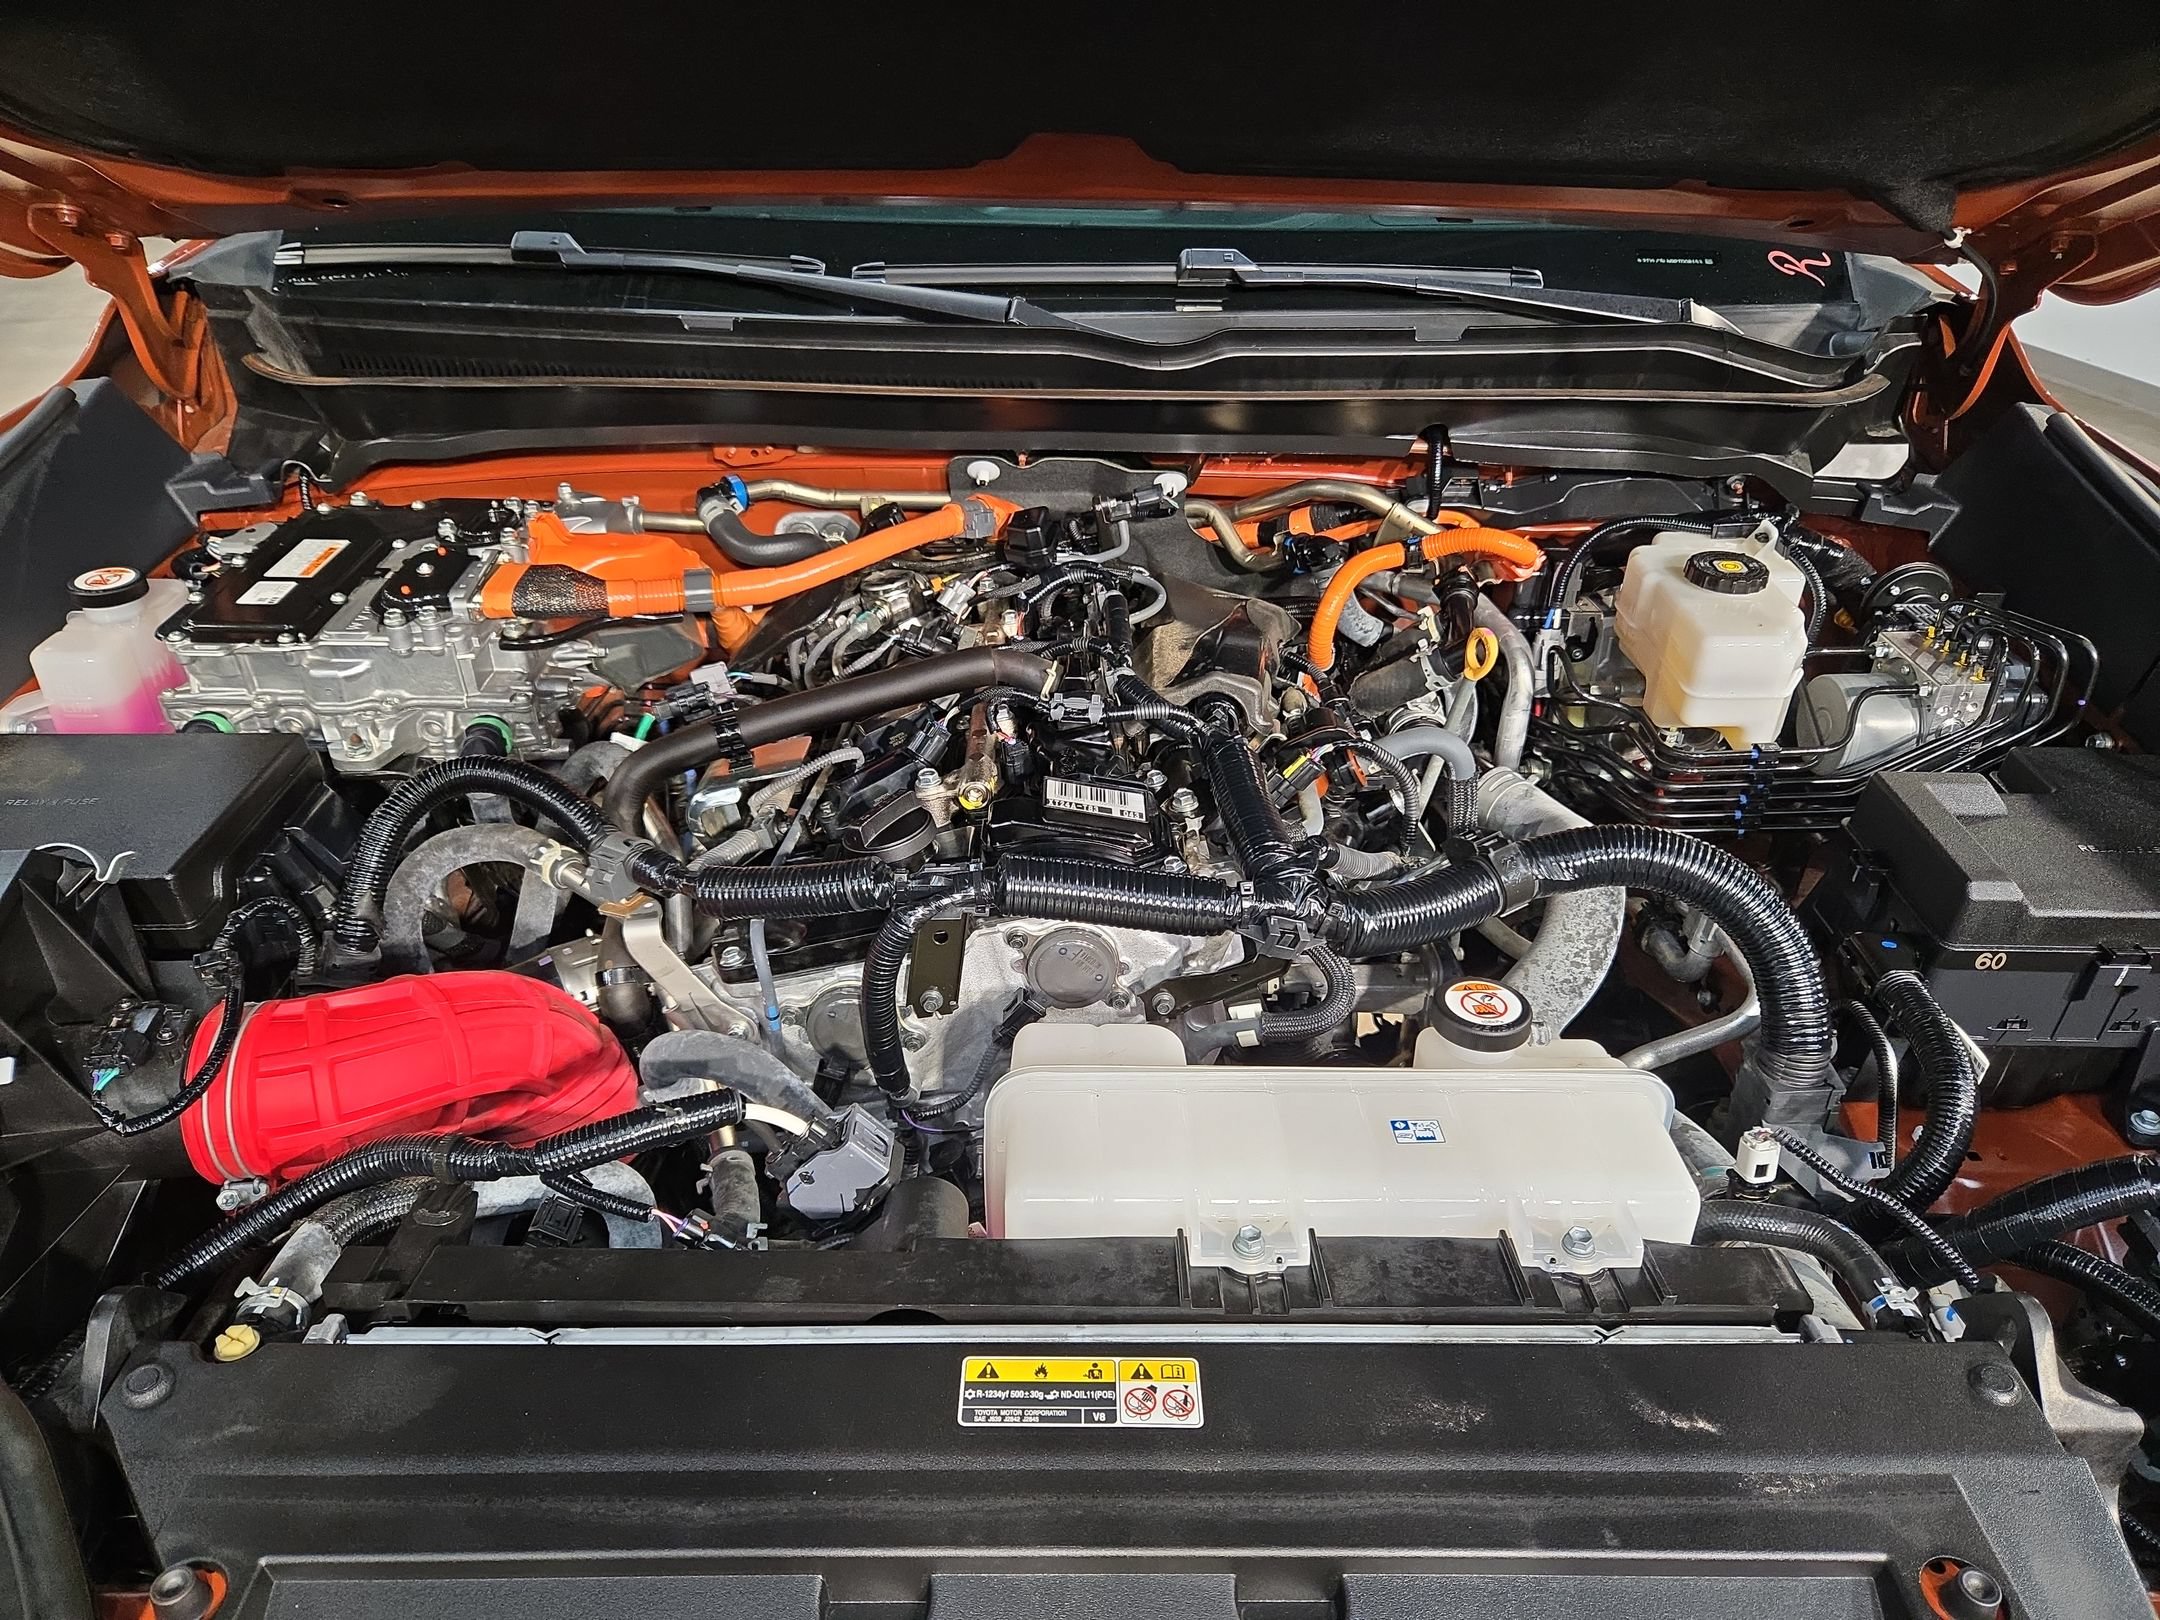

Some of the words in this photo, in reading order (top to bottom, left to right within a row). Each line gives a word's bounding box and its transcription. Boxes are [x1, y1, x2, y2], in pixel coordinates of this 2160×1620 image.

[1767, 250, 1831, 287] R
[1974, 952, 2007, 970] 60
[976, 1389, 1009, 1400] R-1234yf
[1010, 1389, 1044, 1400] 500±30g
[1060, 1390, 1115, 1400] ND-OIL11(POE)
[1092, 1412, 1106, 1422] V8
